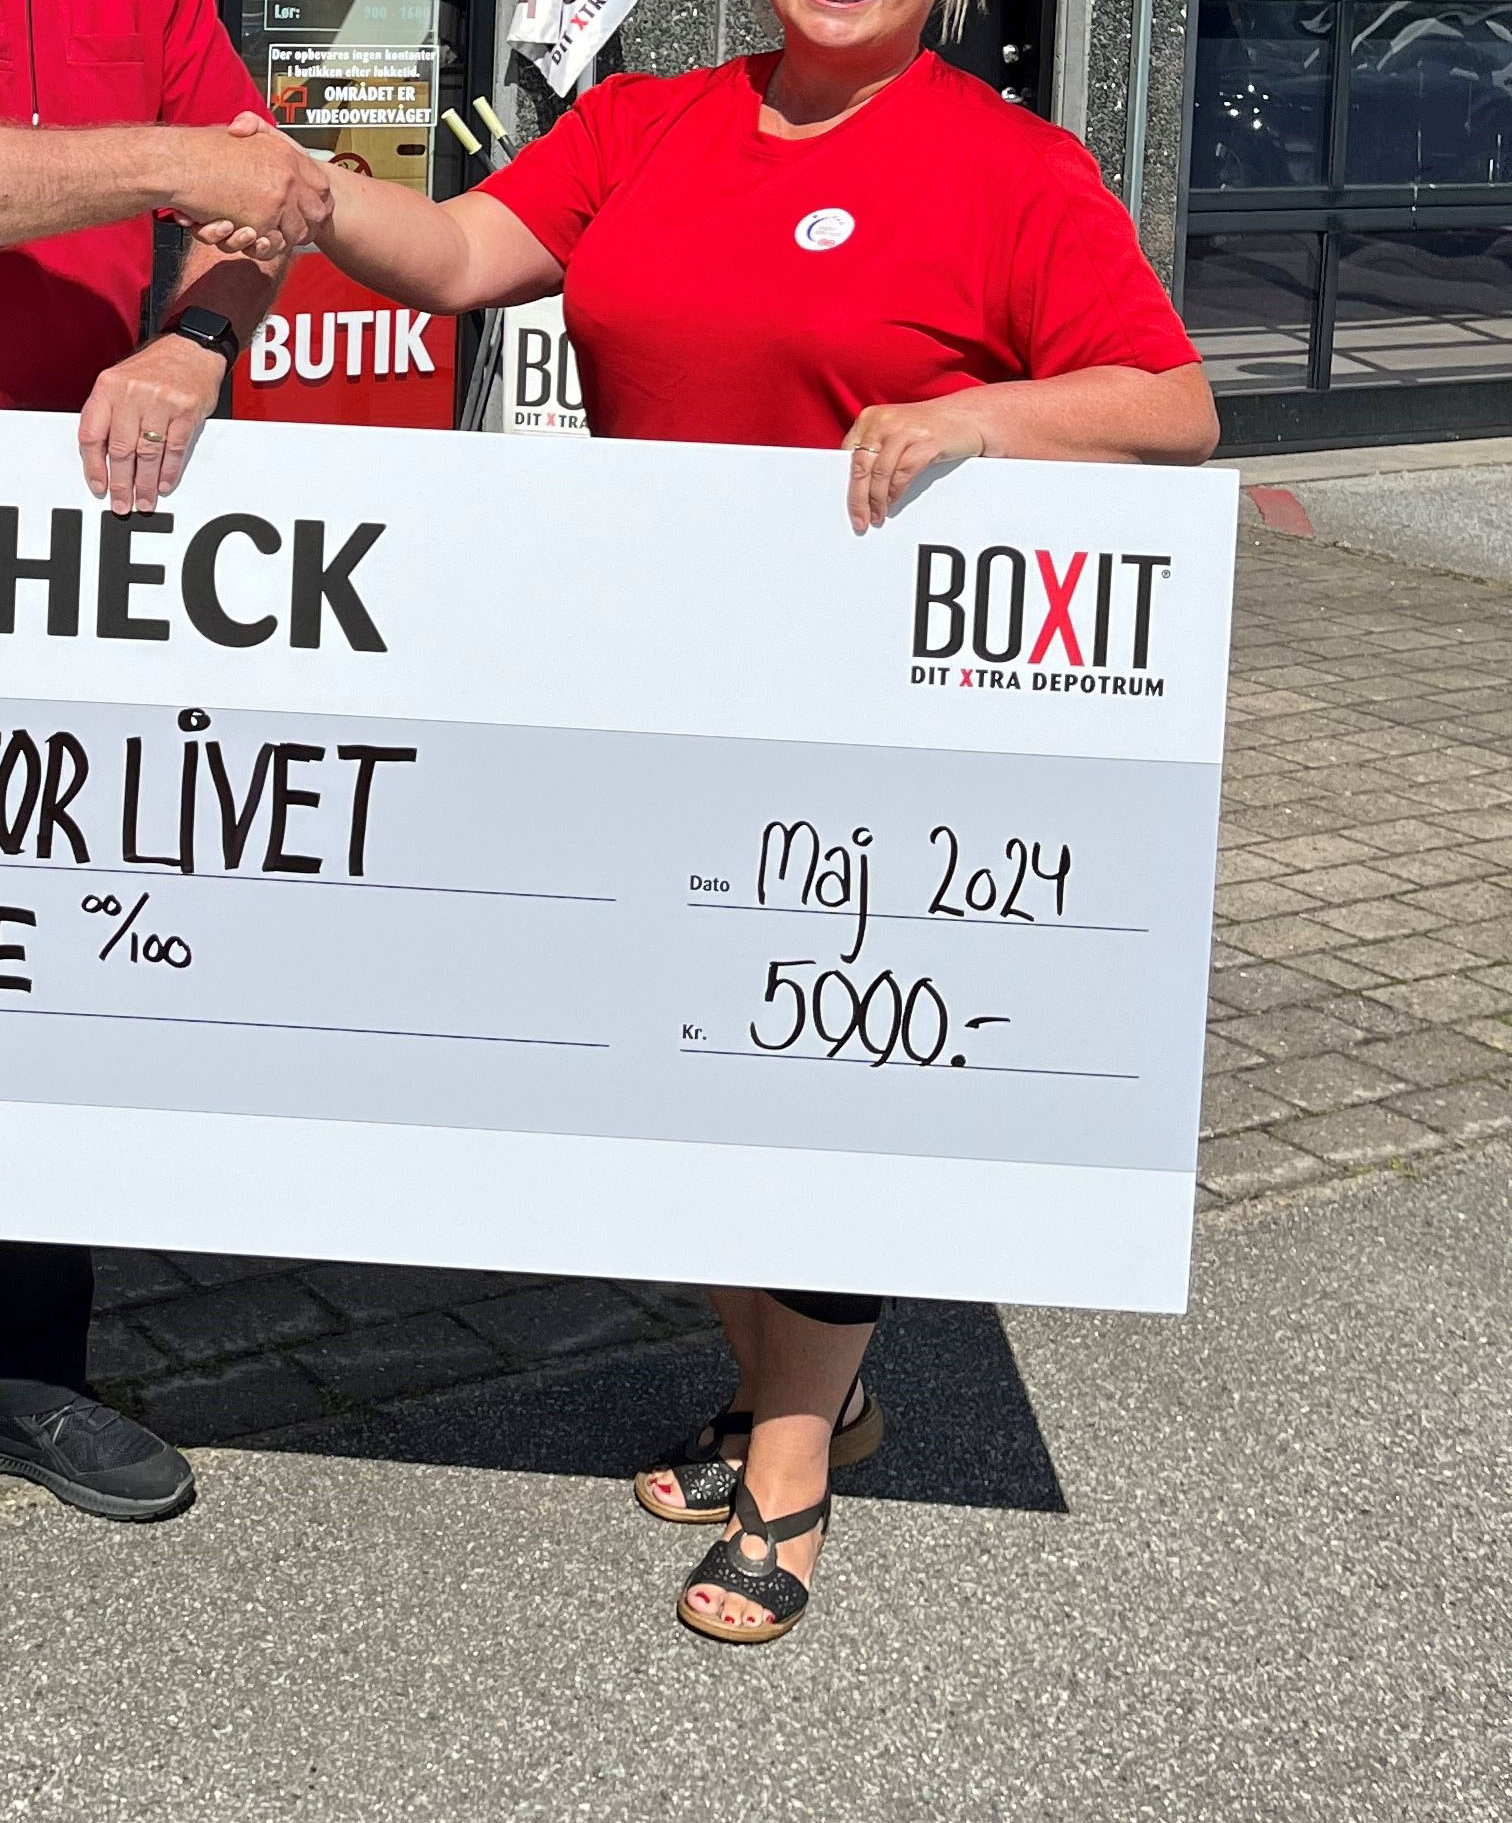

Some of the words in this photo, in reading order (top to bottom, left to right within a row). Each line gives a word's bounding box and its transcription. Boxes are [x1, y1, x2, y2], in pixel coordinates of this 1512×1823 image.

[272, 48, 292, 61] Der
[324, 82, 394, 102] OMRÅDET
[397, 86, 416, 102] ER
[306, 104, 432, 124] VIDEOOVERVÅGET
[250, 308, 436, 382] BUTIK
[515, 412, 541, 426] DIT
[912, 543, 1172, 670] BOXIT
[911, 666, 950, 686] DIT
[960, 669, 1022, 690] XTRA
[1032, 672, 1165, 697] DEPOTRUM
[689, 875, 730, 892] Dato
[929, 826, 1071, 921] 2024
[682, 1024, 707, 1041] Kr.
